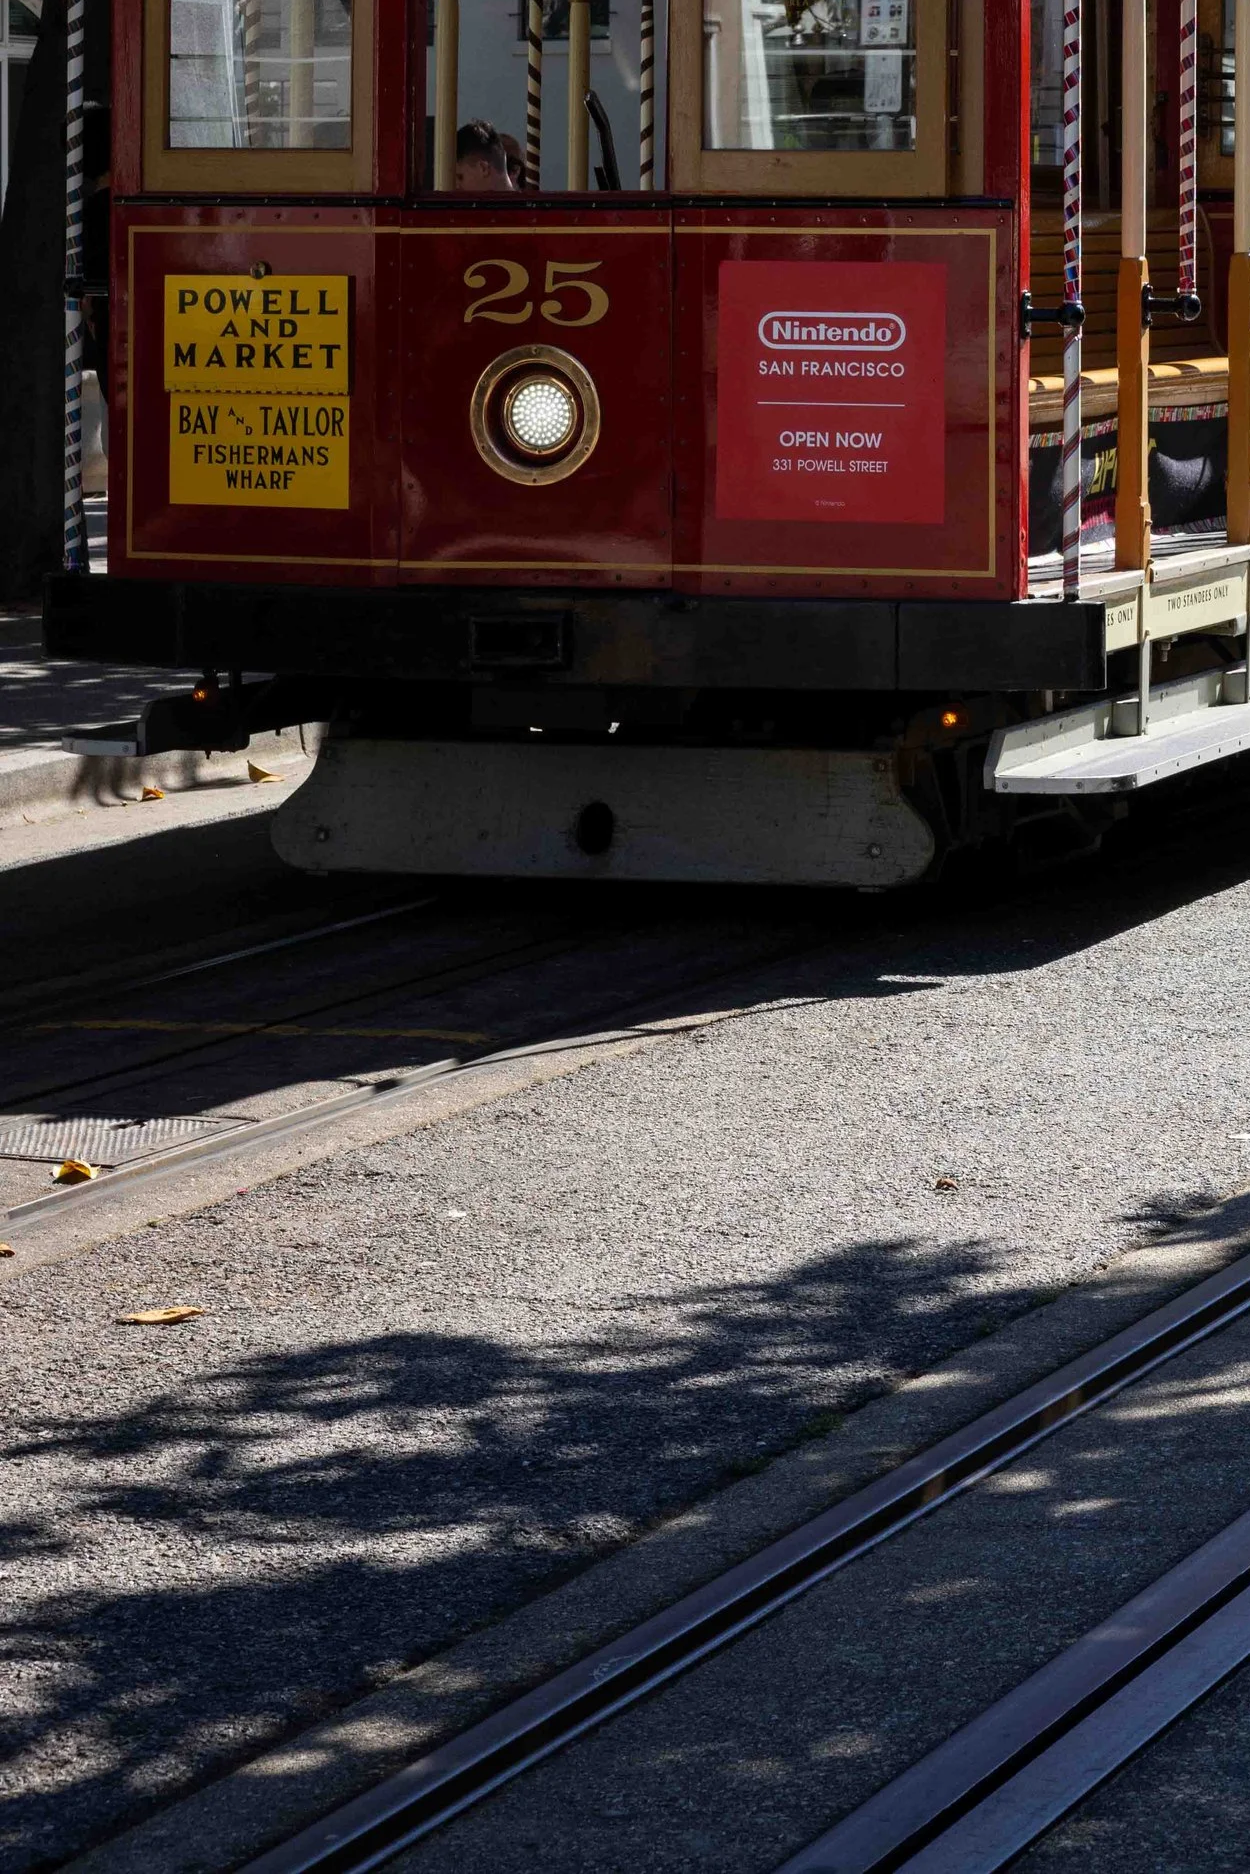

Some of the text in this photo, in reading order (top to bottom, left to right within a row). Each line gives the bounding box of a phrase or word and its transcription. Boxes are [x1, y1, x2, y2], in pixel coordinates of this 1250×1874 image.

[178, 288, 339, 315] POWELL
[463, 259, 609, 326] 25
[220, 319, 298, 338] AND
[174, 343, 341, 369] MARKET
[758, 360, 905, 377] SAN FRANCISCO
[179, 405, 345, 437] BAY AND TAYLOR
[779, 431, 882, 448] OPEN NOW
[193, 444, 329, 466] FISHERMANS
[772, 459, 888, 473] 331 POWELL STREET
[226, 469, 295, 490] WHARF
[1167, 585, 1229, 611] TWO STANDEES ONLY
[1117, 608, 1133, 624] ONLY
